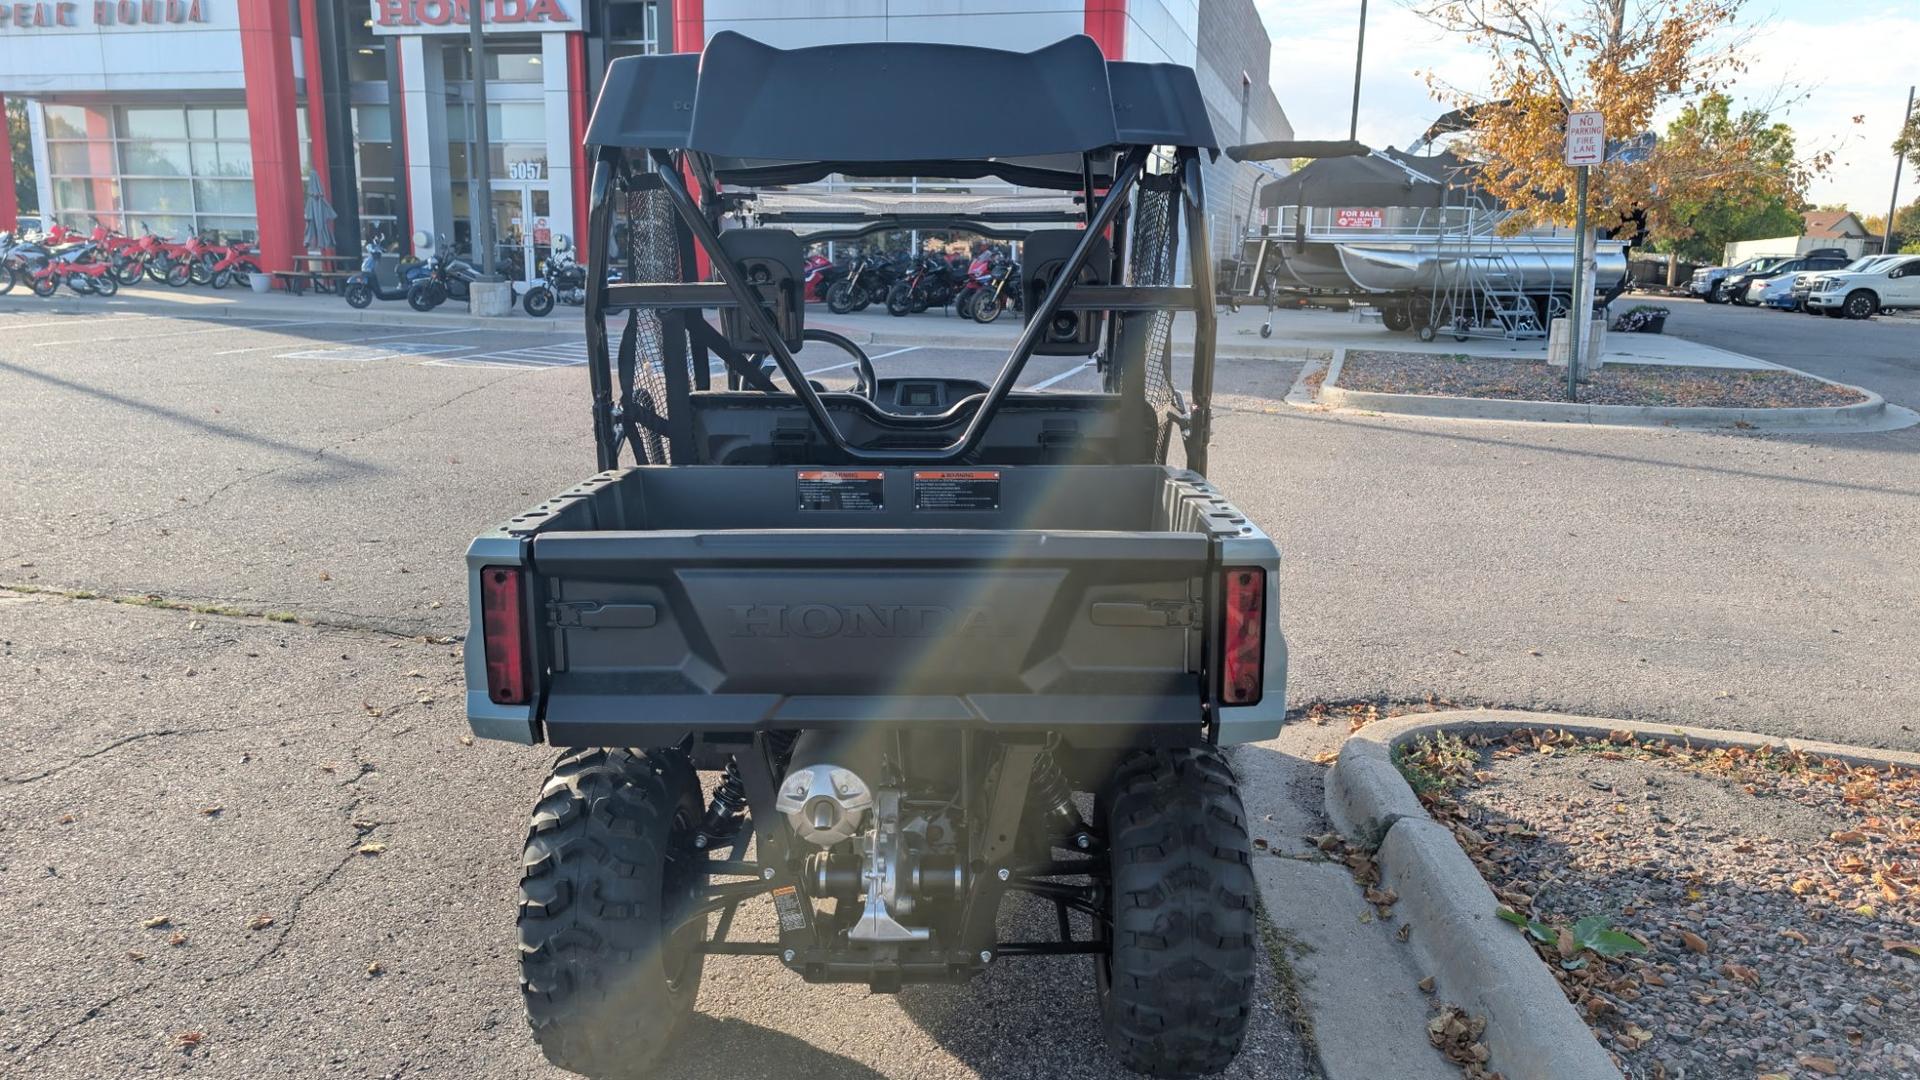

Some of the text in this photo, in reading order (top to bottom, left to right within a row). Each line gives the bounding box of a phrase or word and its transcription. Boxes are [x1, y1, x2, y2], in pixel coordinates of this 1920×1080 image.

[93, 0, 210, 25] HONDA
[377, 0, 572, 26] HONDA
[1579, 117, 1594, 126] NO
[1570, 127, 1602, 136] PARKING
[1576, 136, 1595, 145] FIRE
[1573, 145, 1597, 153] LANE
[510, 162, 541, 179] 5057
[1341, 210, 1380, 218] FOR SALE
[727, 602, 1018, 639] HONDA
